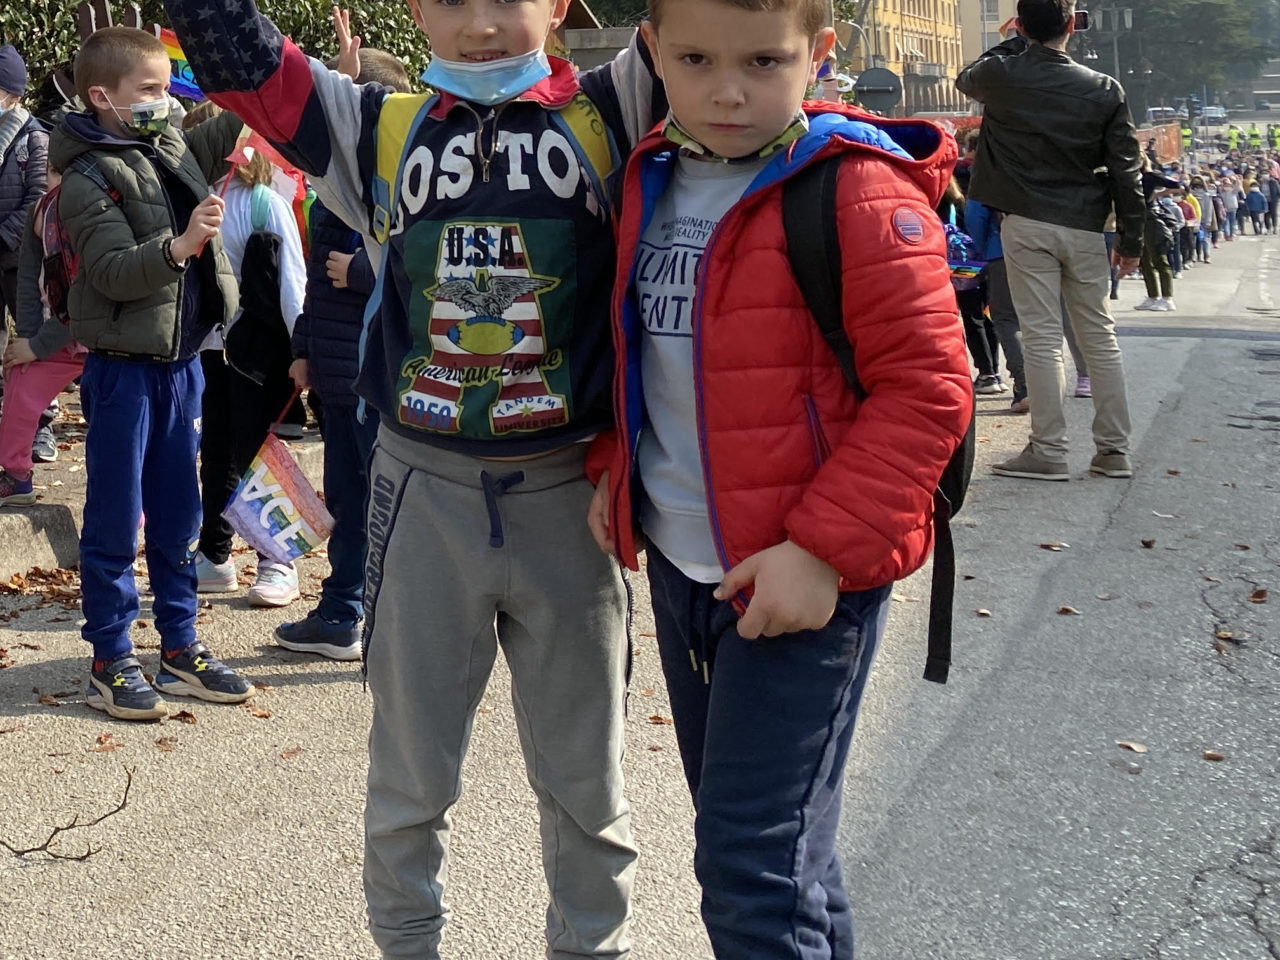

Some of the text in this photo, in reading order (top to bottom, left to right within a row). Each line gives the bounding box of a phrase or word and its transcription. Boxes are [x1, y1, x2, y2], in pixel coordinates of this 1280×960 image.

[389, 129, 605, 236] OSTO
[404, 350, 559, 383] American League
[405, 396, 452, 429] 1950
[496, 396, 557, 417] TANDEM
[494, 416, 566, 433] UNIVERSITY
